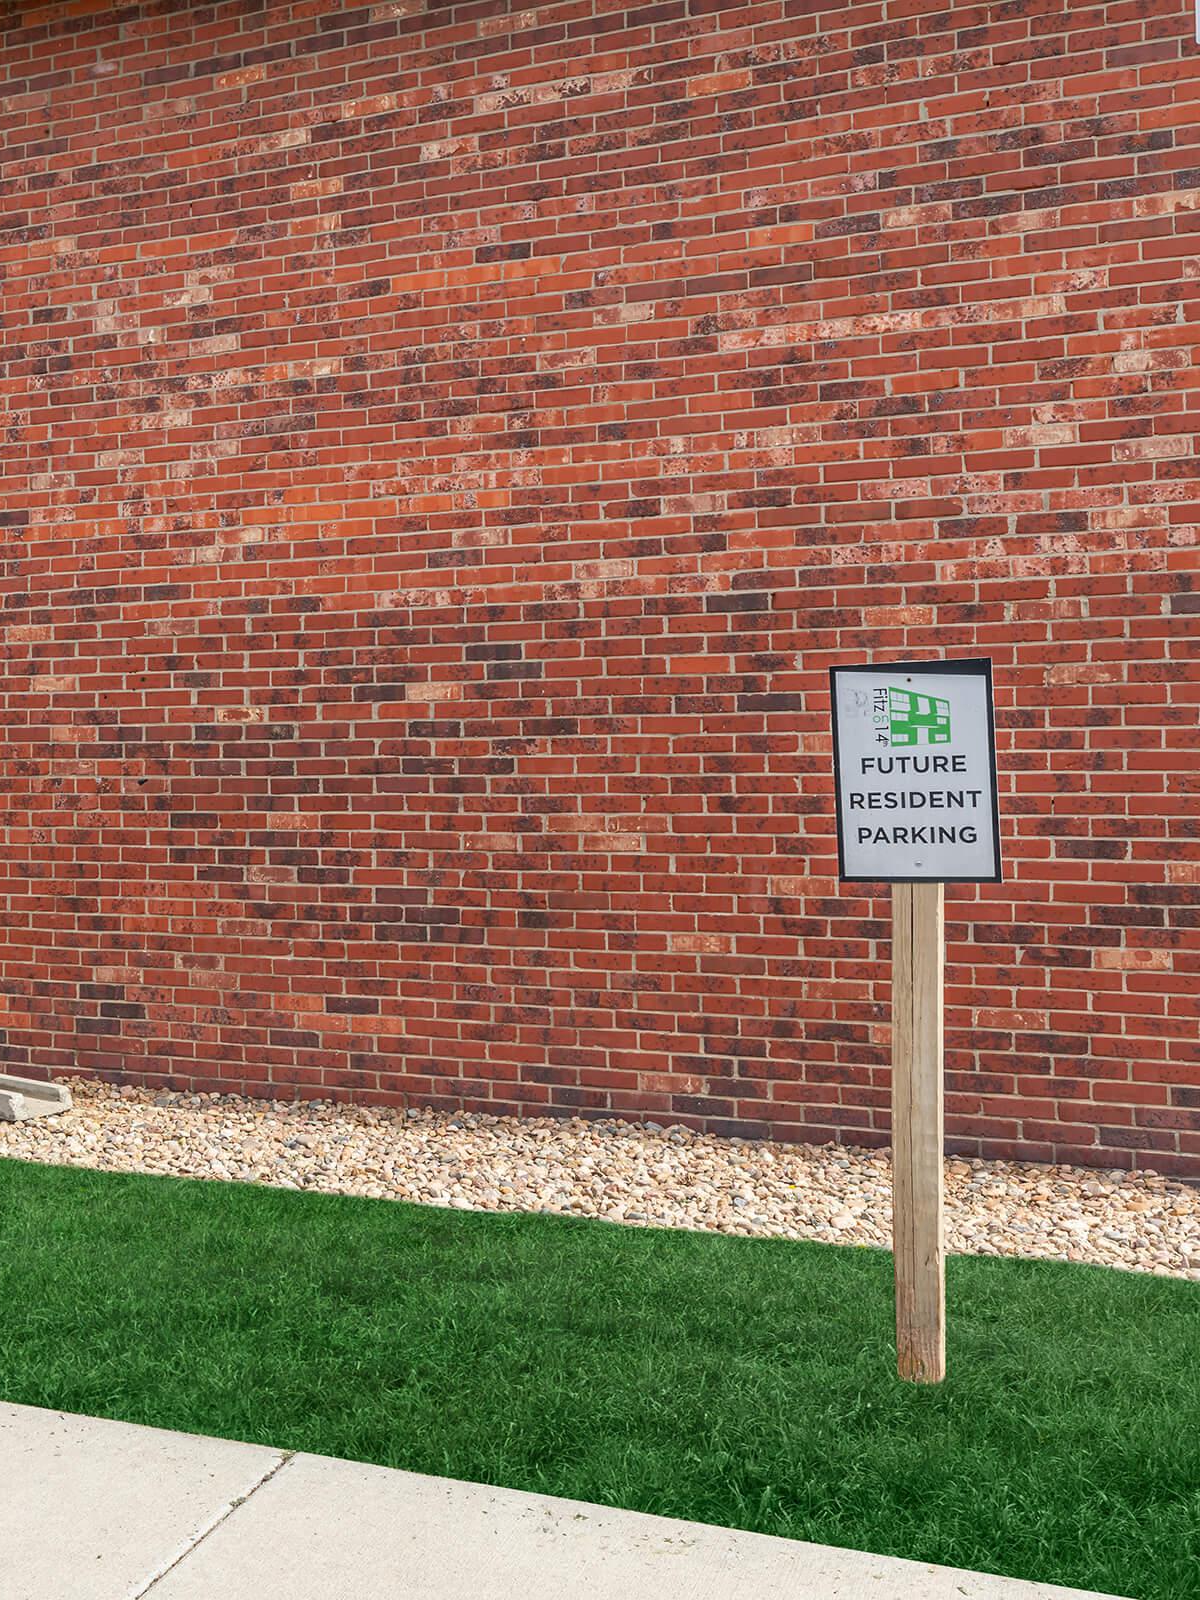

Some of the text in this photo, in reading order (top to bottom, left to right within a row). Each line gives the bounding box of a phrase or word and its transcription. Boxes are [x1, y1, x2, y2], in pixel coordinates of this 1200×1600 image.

[873, 688, 888, 712] Fitz
[861, 755, 967, 774] FUTURE
[850, 790, 982, 809] RESIDENT
[858, 826, 978, 844] PARKING
